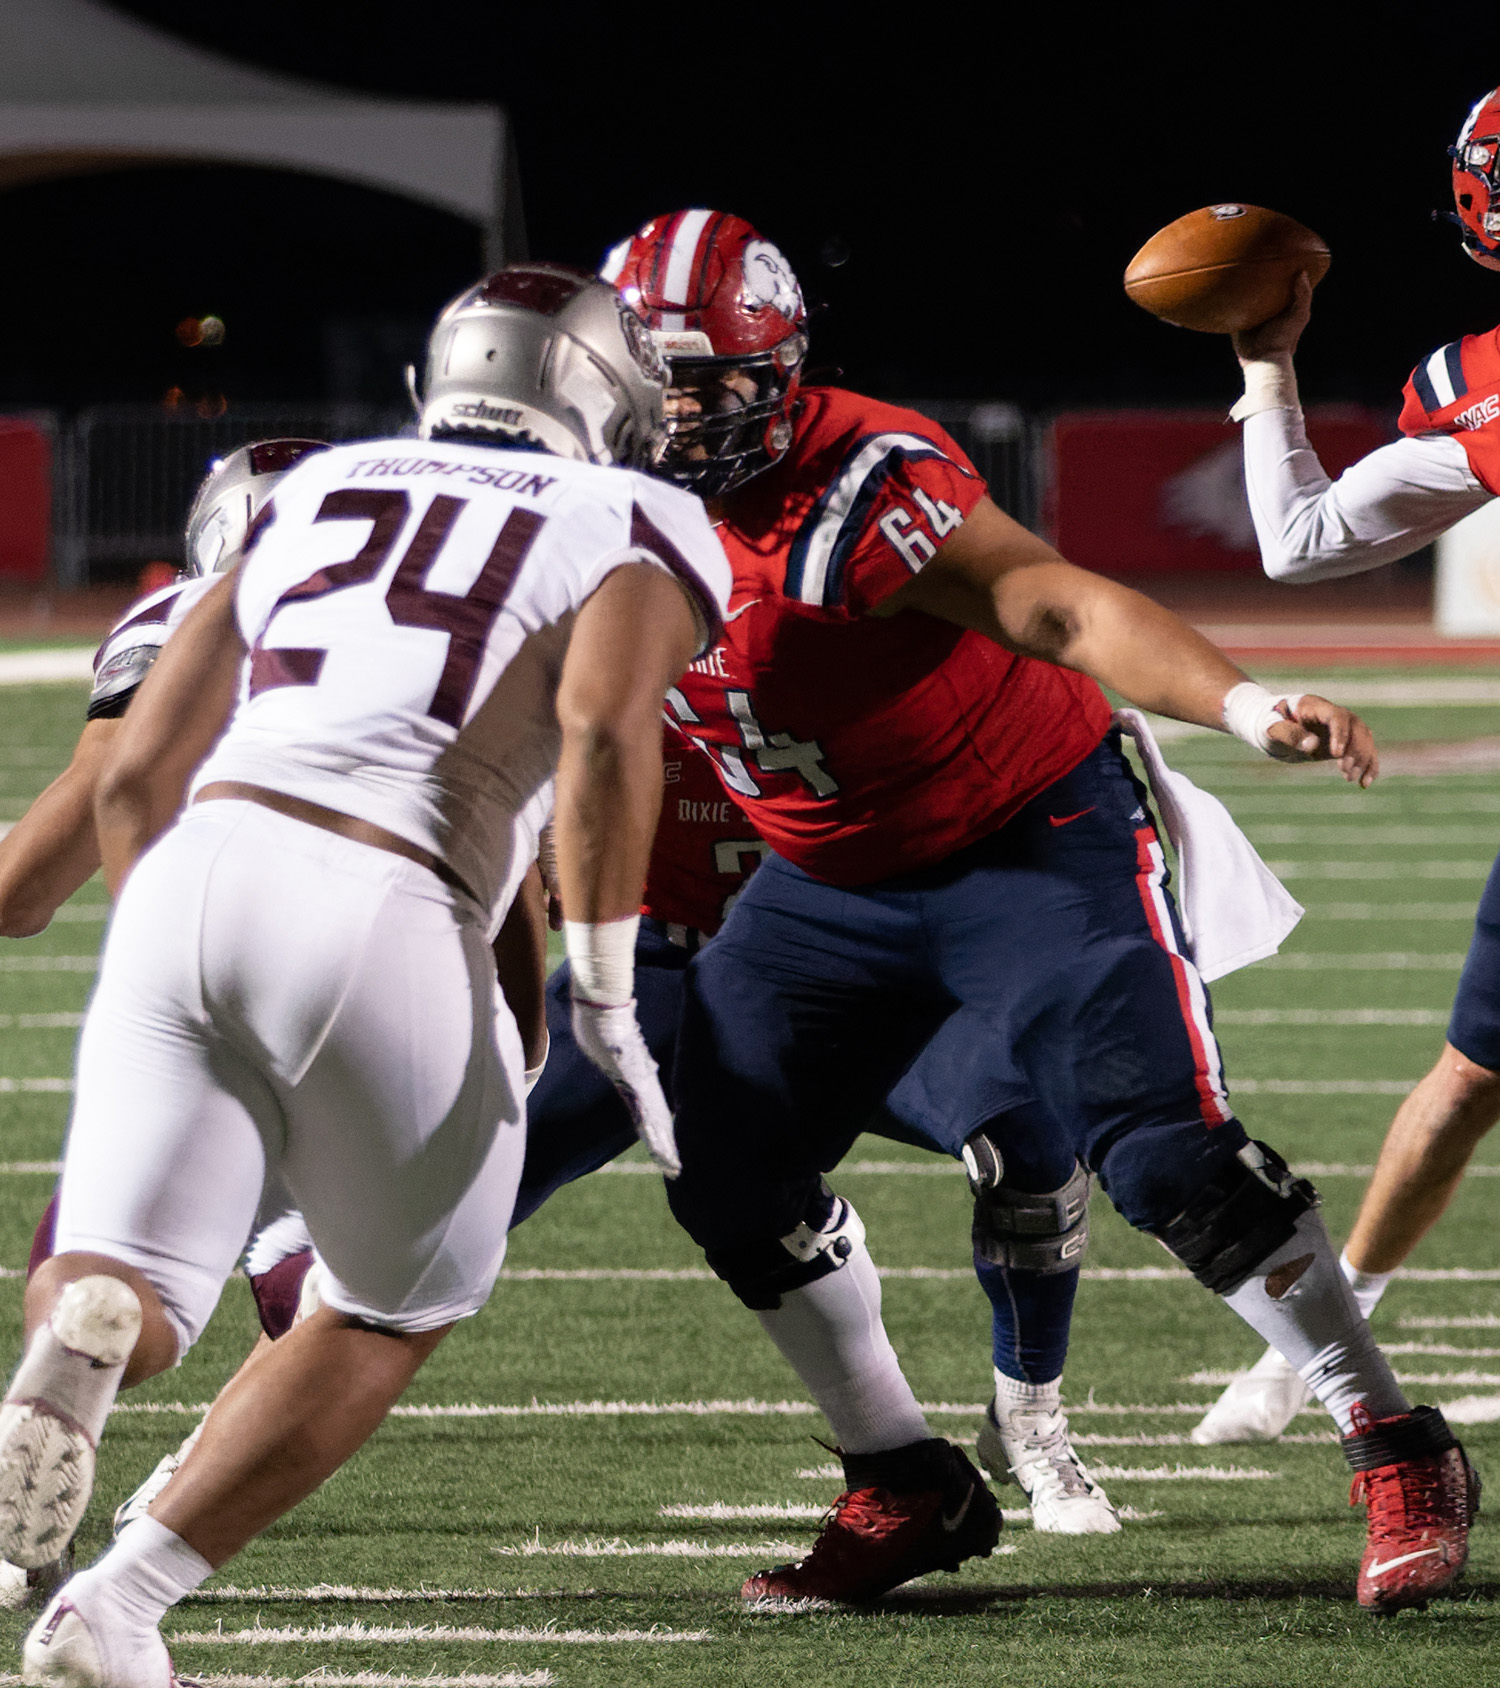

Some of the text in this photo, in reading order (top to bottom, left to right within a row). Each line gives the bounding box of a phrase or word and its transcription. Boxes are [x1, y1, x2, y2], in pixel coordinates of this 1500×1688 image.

[1454, 393, 1500, 432] WAC
[346, 457, 559, 498] THOMPSON
[878, 486, 966, 574] 64
[248, 487, 547, 730] 24
[677, 798, 731, 823] DIXIE
